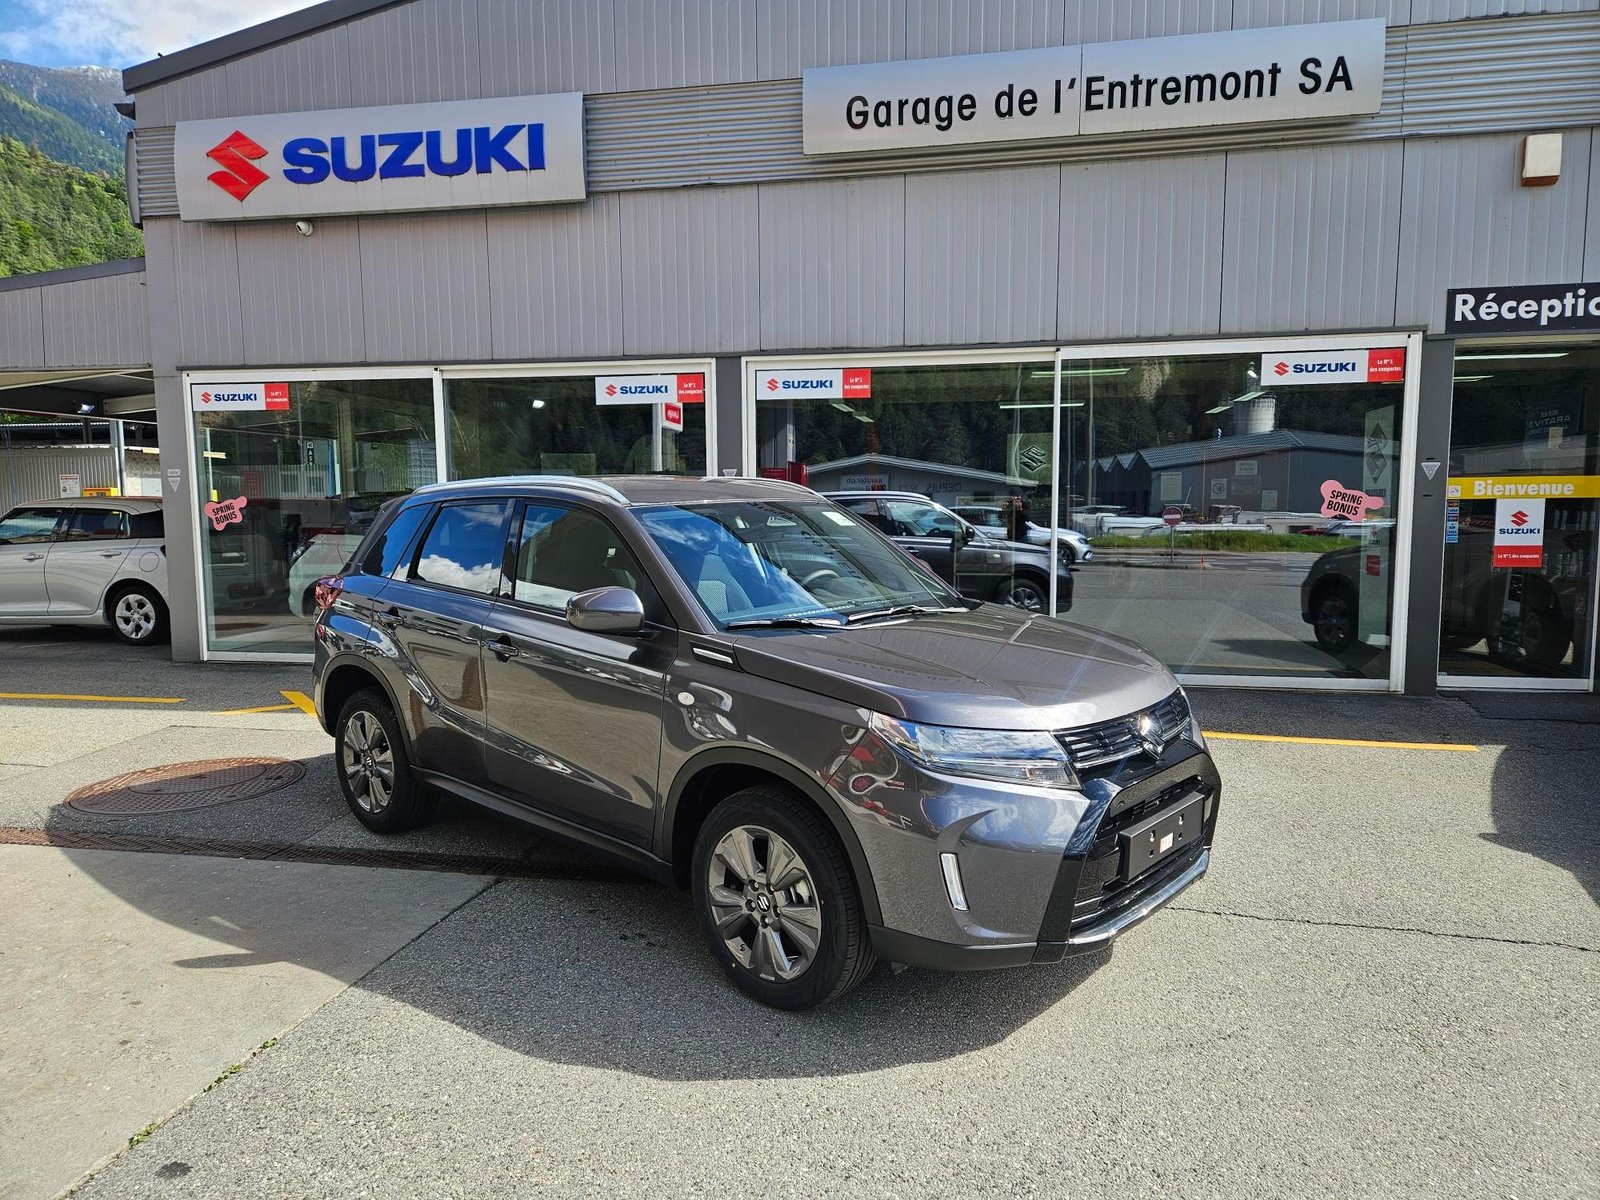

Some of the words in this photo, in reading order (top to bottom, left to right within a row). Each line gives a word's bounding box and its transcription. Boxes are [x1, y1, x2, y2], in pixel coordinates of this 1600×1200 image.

[846, 93, 977, 132] Garage
[993, 83, 1038, 120] de
[1298, 55, 1355, 96] SA
[282, 122, 545, 185] SUZUKI
[1292, 362, 1356, 374] SUZUKI
[620, 385, 668, 395] SUZUKI
[782, 380, 833, 389] SUZUKI
[214, 393, 257, 402] SUZUKI
[1473, 479, 1575, 497] Bienvenue
[1329, 489, 1364, 506] SPRING
[212, 502, 235, 516] SPRING
[1326, 499, 1360, 516] BONUS
[214, 511, 238, 525] BONUS
